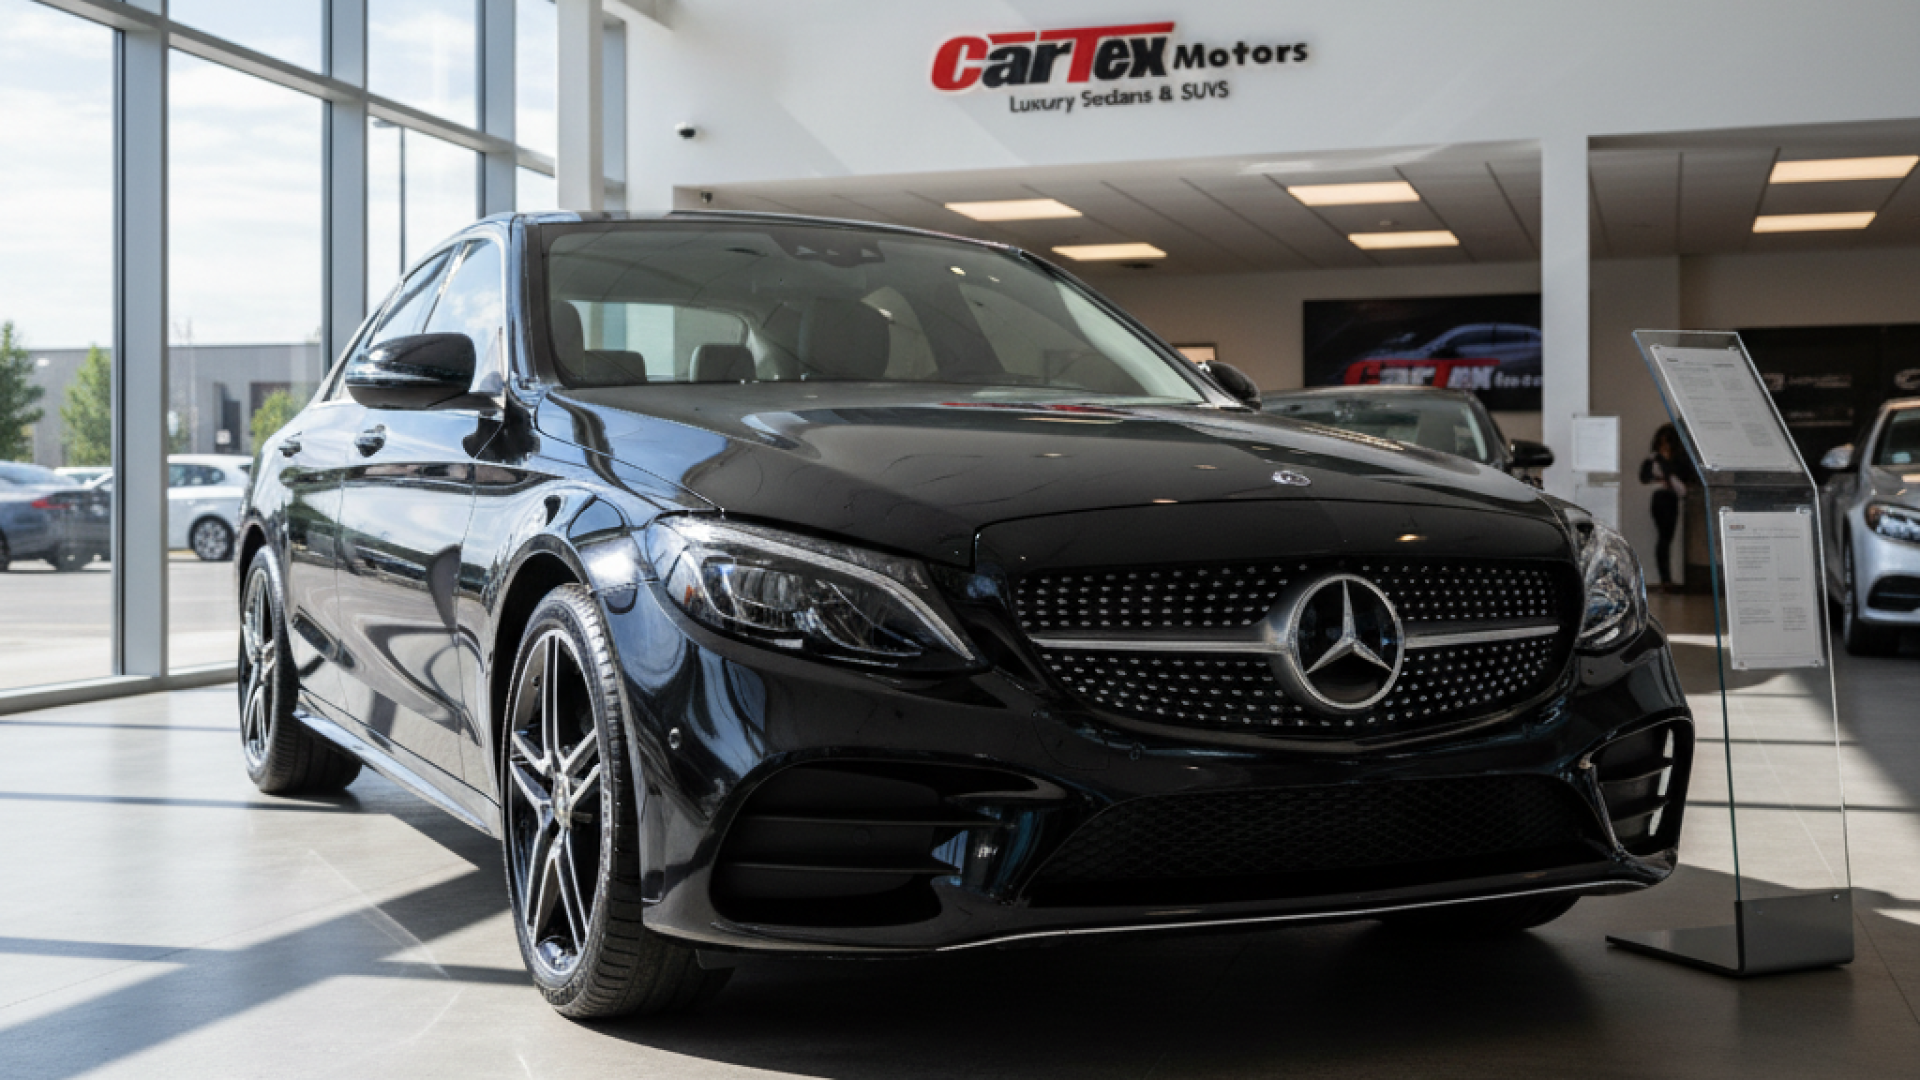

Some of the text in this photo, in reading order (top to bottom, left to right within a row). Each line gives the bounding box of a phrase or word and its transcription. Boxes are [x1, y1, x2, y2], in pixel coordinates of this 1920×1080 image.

[931, 21, 1308, 91] CarTex Motors
[1009, 96, 1075, 113] Luxury
[1081, 89, 1153, 107] Sedans
